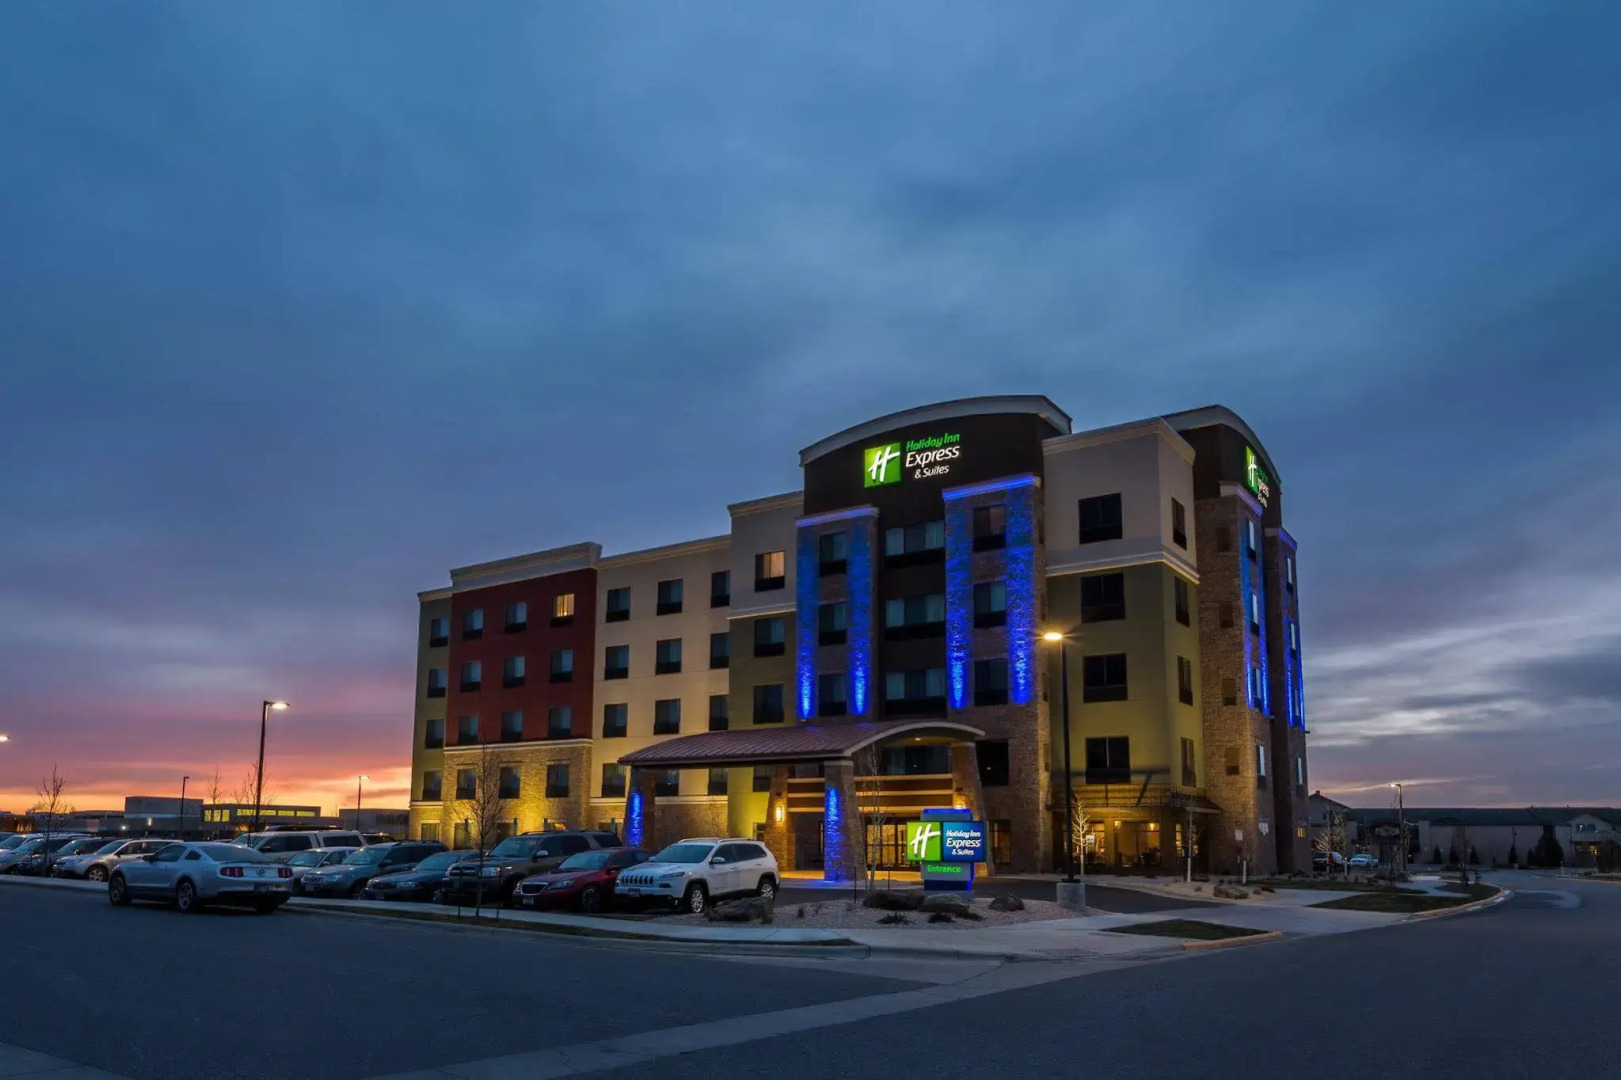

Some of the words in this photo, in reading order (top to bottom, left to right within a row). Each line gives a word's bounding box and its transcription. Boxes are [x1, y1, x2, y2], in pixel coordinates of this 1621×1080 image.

[906, 437, 943, 451] Holiday
[943, 433, 960, 443] Inn
[905, 446, 960, 467] Express
[915, 469, 922, 479] &
[922, 465, 949, 477] Suites
[946, 830, 970, 838] Holiday
[946, 838, 981, 848] Express
[927, 865, 961, 873] Entrance
